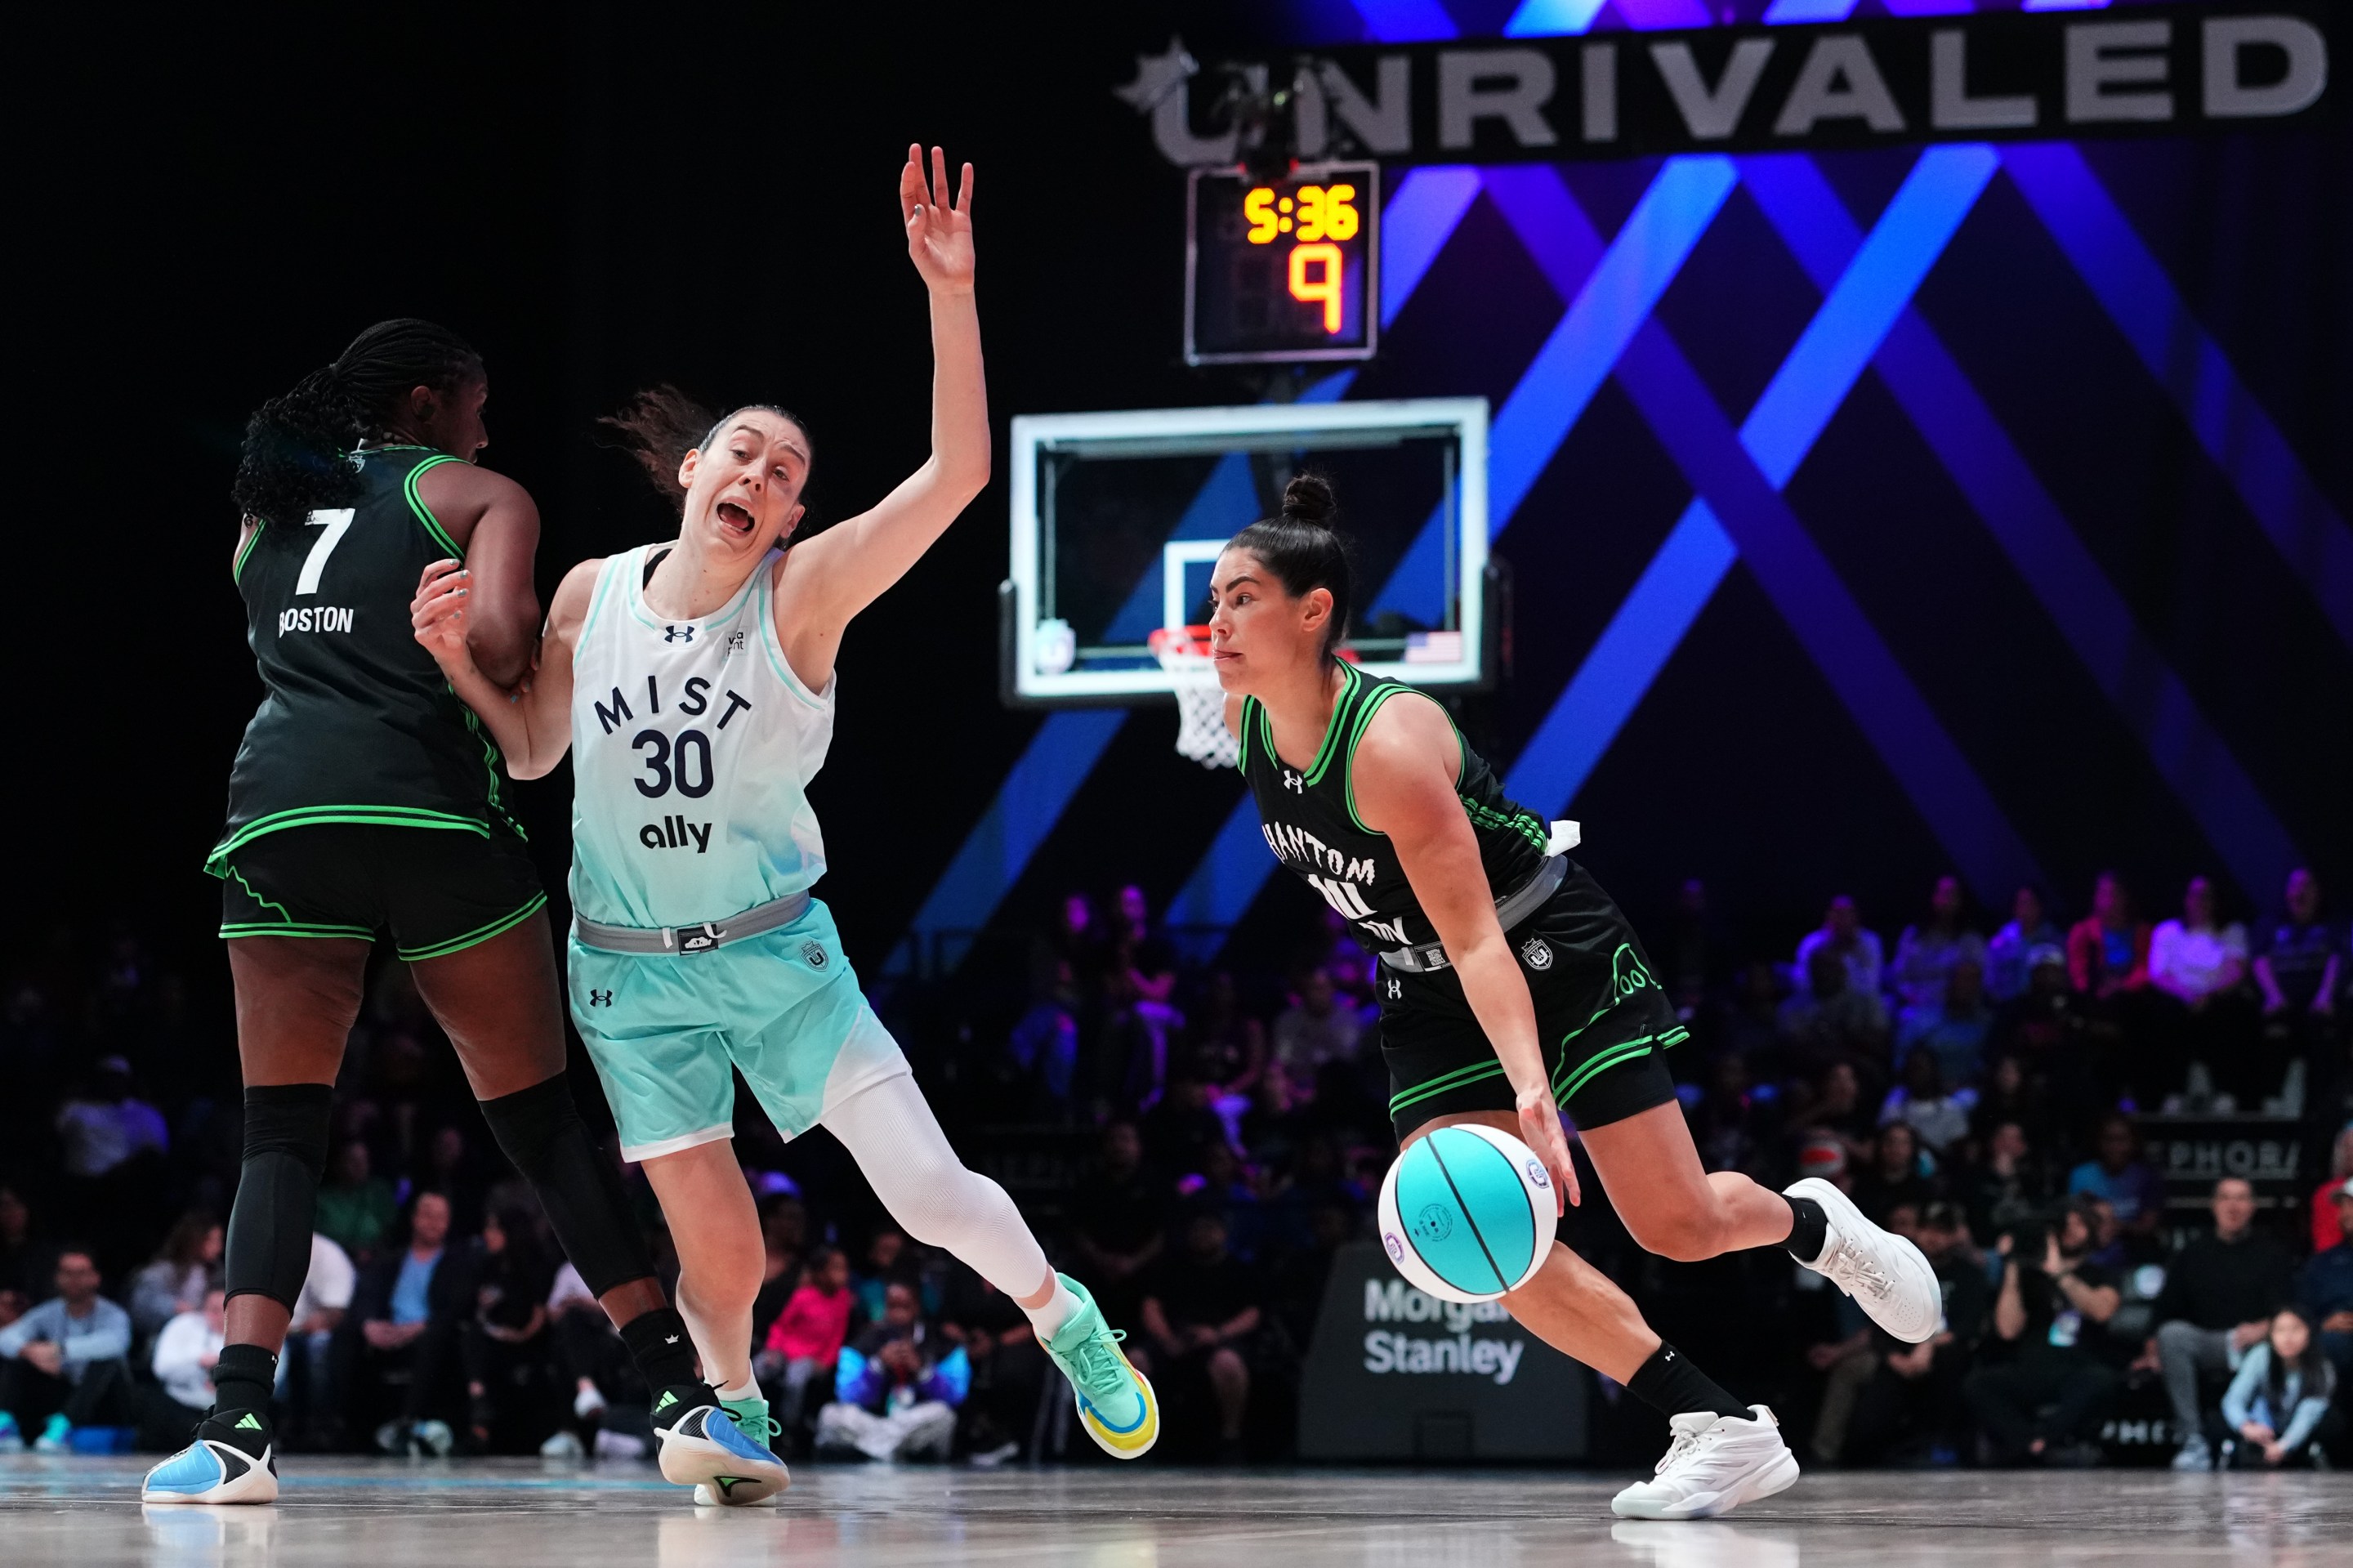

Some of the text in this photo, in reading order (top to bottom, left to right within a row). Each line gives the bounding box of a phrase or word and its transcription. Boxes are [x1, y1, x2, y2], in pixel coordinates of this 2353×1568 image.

[1150, 15, 2328, 165] UNRIVALED
[1243, 183, 1360, 244] 5:36
[1288, 243, 1343, 334] 9
[295, 507, 356, 596] 7
[279, 606, 354, 639] BOSTON
[593, 675, 752, 735] MIST
[631, 729, 714, 799] 30
[639, 815, 712, 854] ally
[1261, 820, 1376, 887] HANTOM
[1363, 1329, 1525, 1386] Stanley
